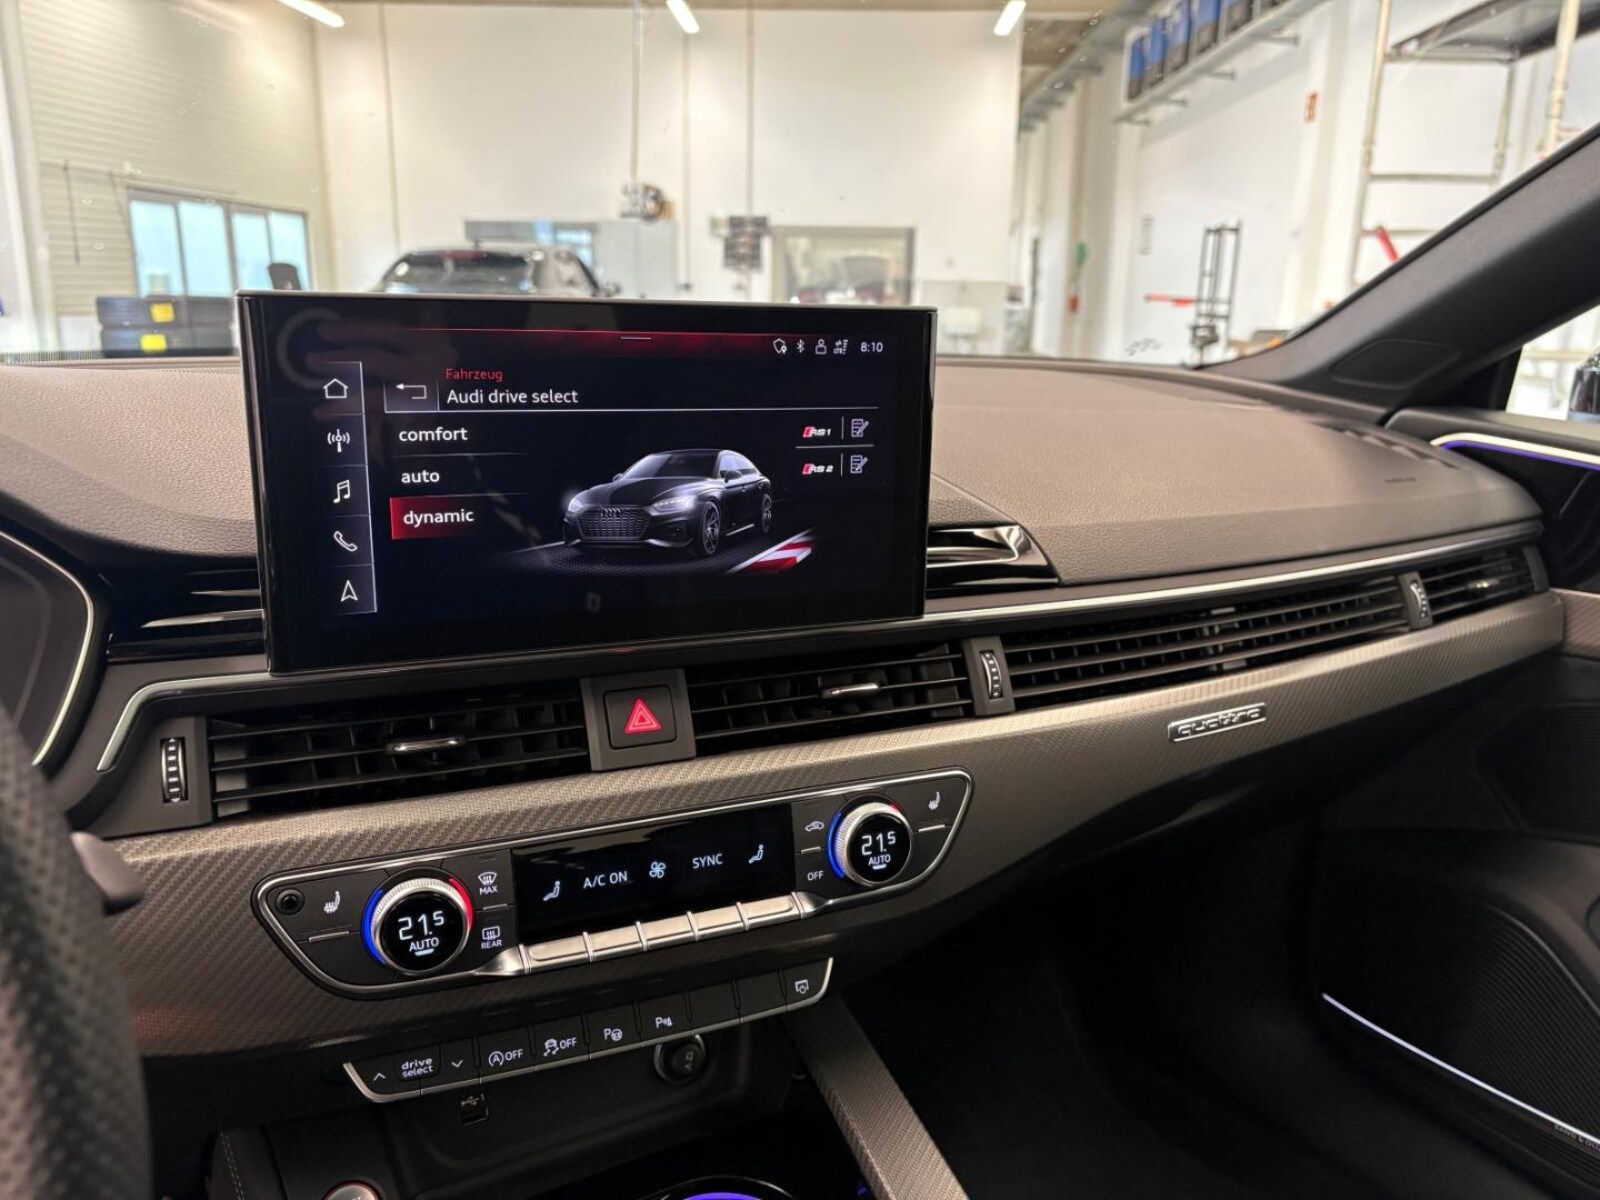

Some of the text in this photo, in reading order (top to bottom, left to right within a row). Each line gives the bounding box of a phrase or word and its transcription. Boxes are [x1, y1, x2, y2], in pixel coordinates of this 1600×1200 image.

[860, 341, 884, 353] 8:10
[445, 368, 503, 382] Fahrzeug
[446, 389, 579, 404] Audi drive select
[398, 426, 469, 442] comfort
[401, 469, 441, 484] auto
[403, 508, 475, 528] dynamic
[1177, 707, 1261, 737] quattro
[692, 852, 724, 870] SYNC
[868, 853, 892, 867] AUTO
[582, 870, 629, 890] A/C ON
[806, 870, 825, 882] OFF
[478, 885, 499, 896] MAX
[408, 937, 440, 953] AUTO
[480, 939, 503, 951] REAR
[559, 1036, 578, 1050] OFF
[504, 1048, 524, 1062] OFF
[401, 1056, 433, 1070] drive
[401, 1065, 434, 1079] select
